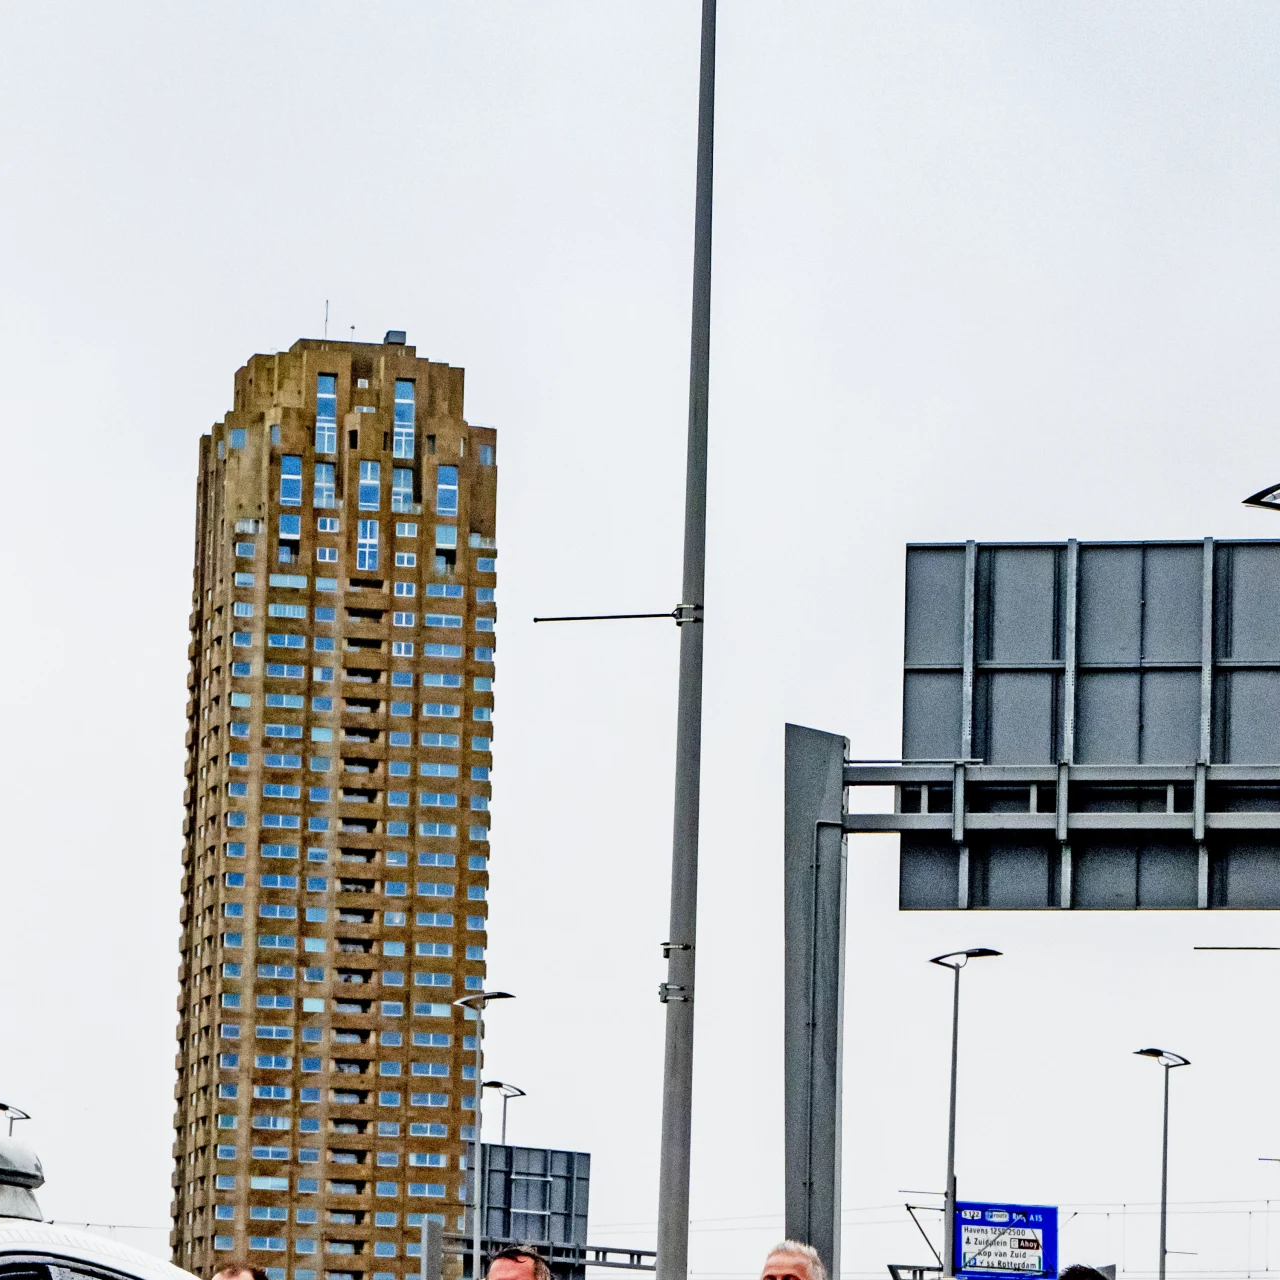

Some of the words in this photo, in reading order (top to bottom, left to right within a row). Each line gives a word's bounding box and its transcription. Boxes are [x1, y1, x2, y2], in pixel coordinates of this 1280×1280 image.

[963, 1226, 988, 1235] Havens
[990, 1228, 1026, 1236] 1250-2500
[974, 1238, 1007, 1248] Zuidplein
[1020, 1240, 1038, 1250] Ahoy
[978, 1249, 992, 1258] Kop
[1010, 1250, 1027, 1259] Zuid
[997, 1260, 1037, 1270] Rotterdam
